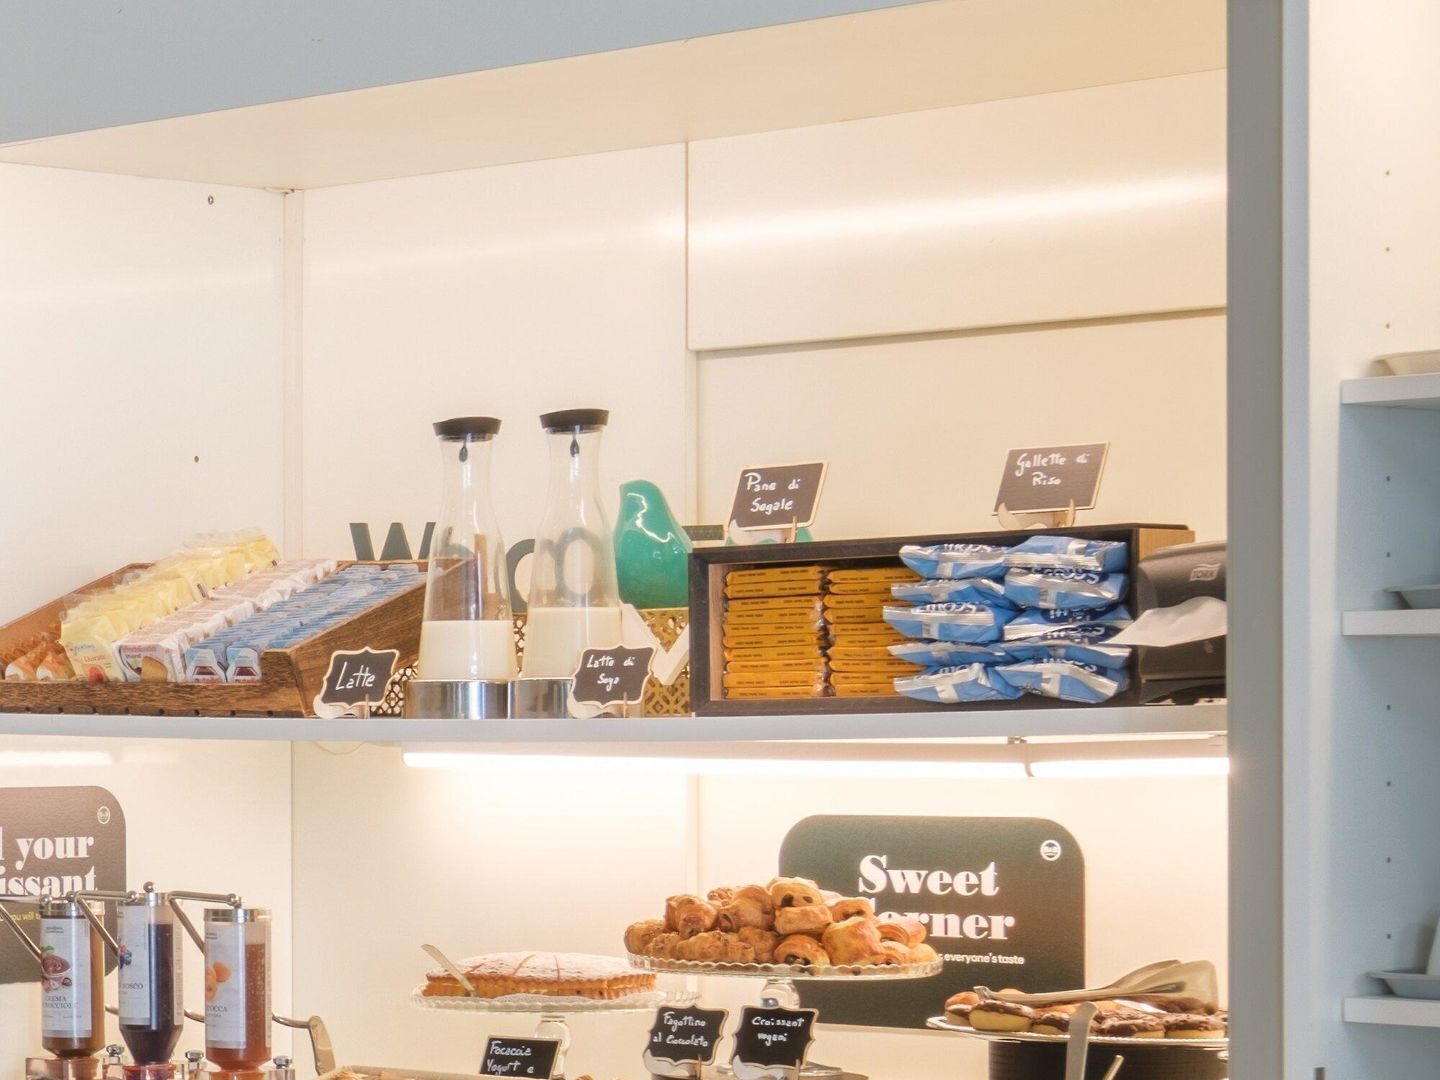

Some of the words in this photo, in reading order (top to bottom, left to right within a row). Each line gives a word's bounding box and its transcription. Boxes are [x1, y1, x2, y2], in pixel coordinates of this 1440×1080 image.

[1015, 453, 1066, 477] Gallette
[1076, 453, 1090, 464] di
[744, 472, 777, 492] Pane
[788, 478, 801, 490] di
[1032, 471, 1061, 486] Riso
[587, 654, 615, 668] Latte
[623, 656, 636, 667] di
[335, 662, 376, 690] Latte
[15, 836, 95, 871] your
[858, 855, 1000, 897] Sweet
[868, 897, 1016, 940] rner
[944, 952, 997, 965] everyone's
[998, 953, 1026, 965] taste
[662, 1011, 707, 1032] Fagottino
[489, 1040, 532, 1057] Focaccia
[652, 1032, 662, 1043] al
[666, 1034, 709, 1048] Cioccolato
[486, 1059, 521, 1075] Yogurt
